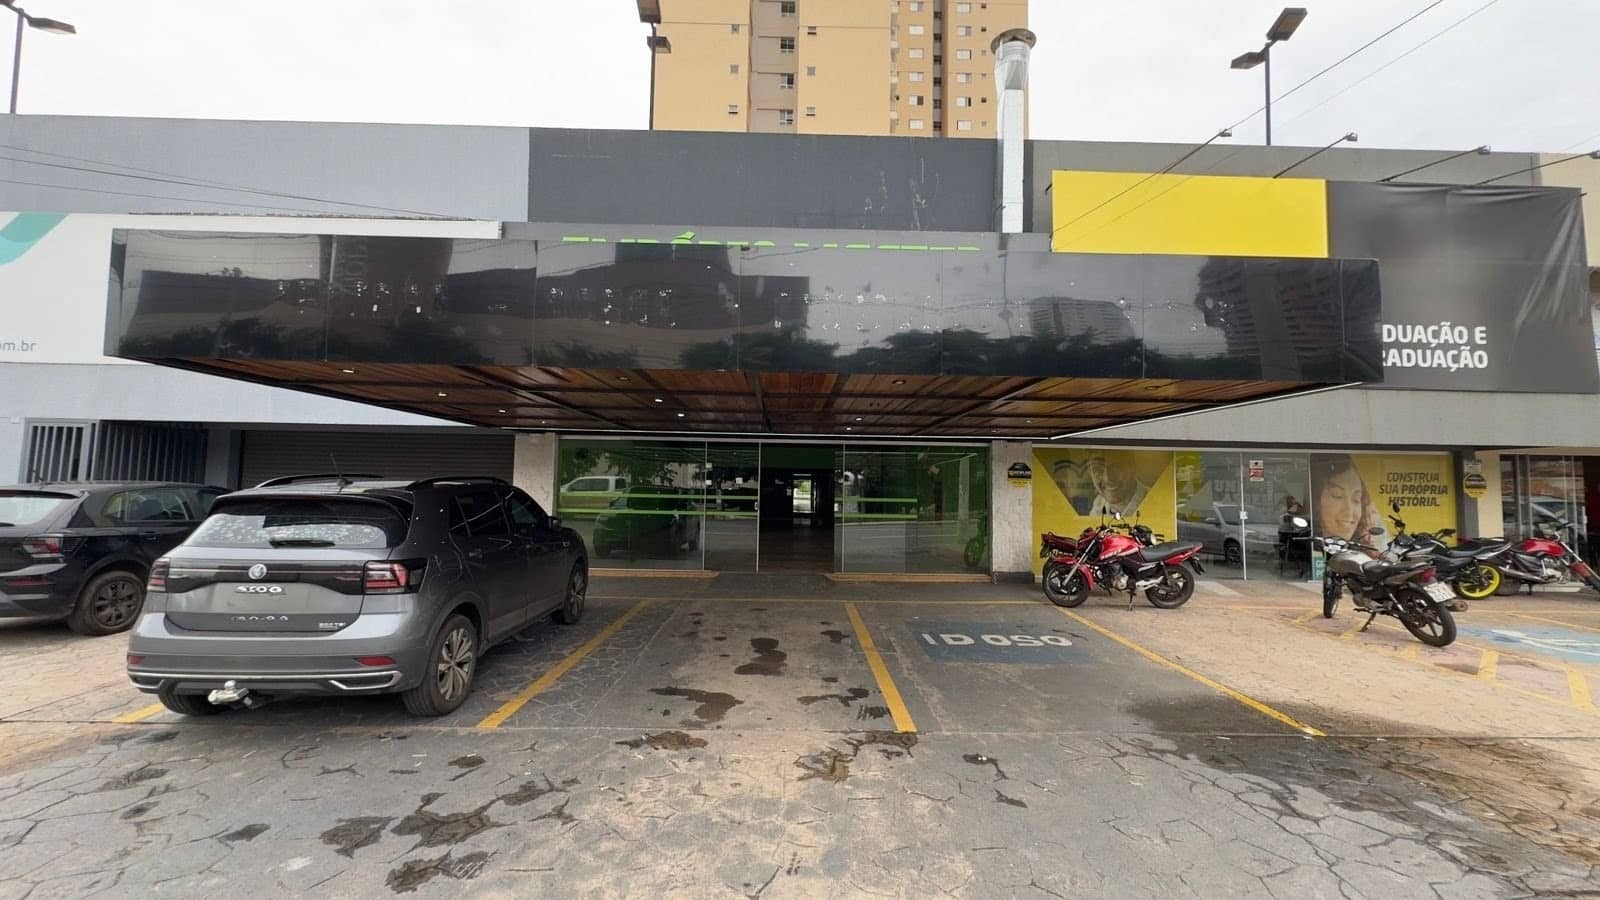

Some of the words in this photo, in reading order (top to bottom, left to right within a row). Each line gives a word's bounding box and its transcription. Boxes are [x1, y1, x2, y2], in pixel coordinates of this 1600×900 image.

[1382, 321, 1468, 347] DUAÇÃO
[1474, 326, 1488, 345] E
[0, 339, 37, 352] m.br
[1386, 471, 1440, 482] CONSTRUA
[1378, 484, 1399, 495] SUA
